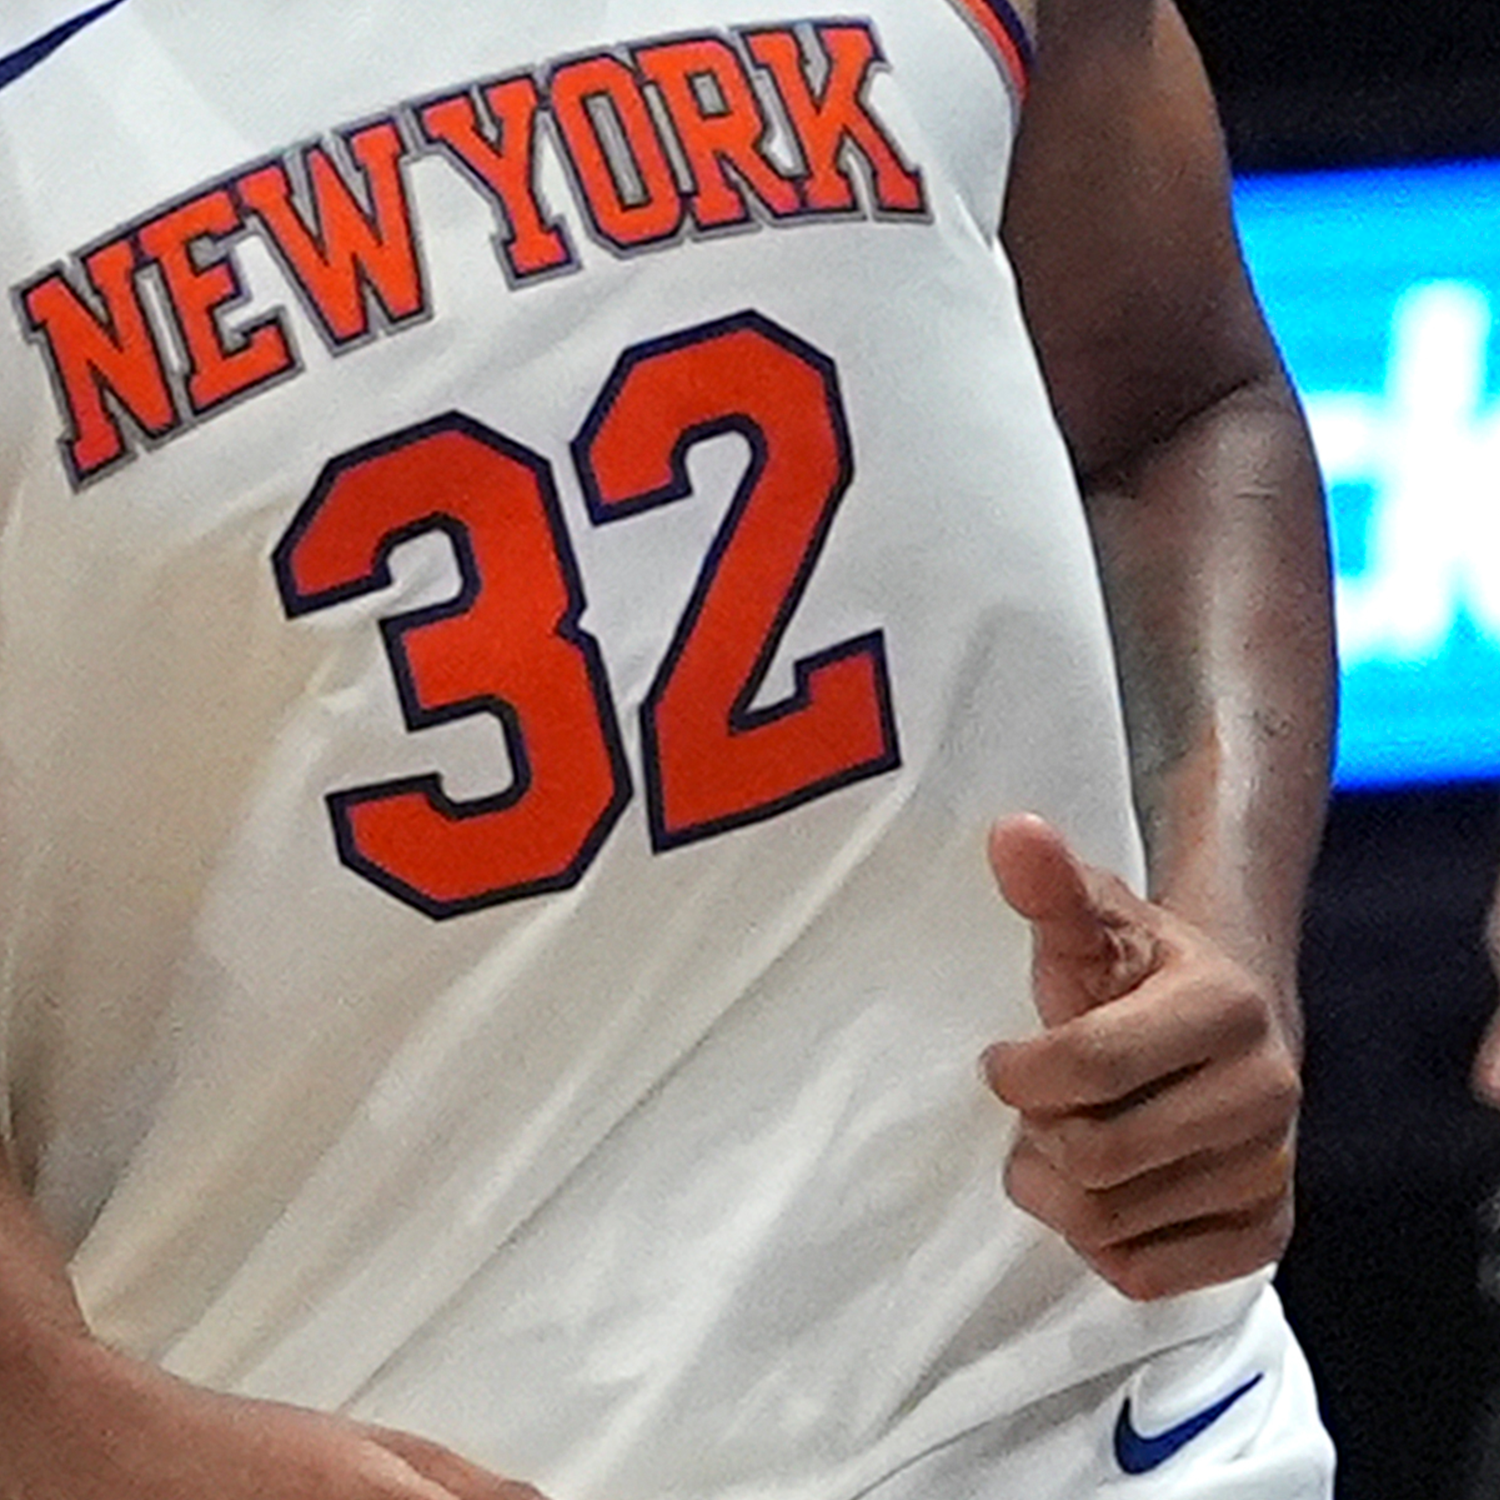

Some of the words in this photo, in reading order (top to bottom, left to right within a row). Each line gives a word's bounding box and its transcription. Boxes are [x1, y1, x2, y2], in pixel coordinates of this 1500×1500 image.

[10, 110, 434, 495] NEW
[402, 15, 933, 290] YORK
[270, 309, 903, 922] 32
